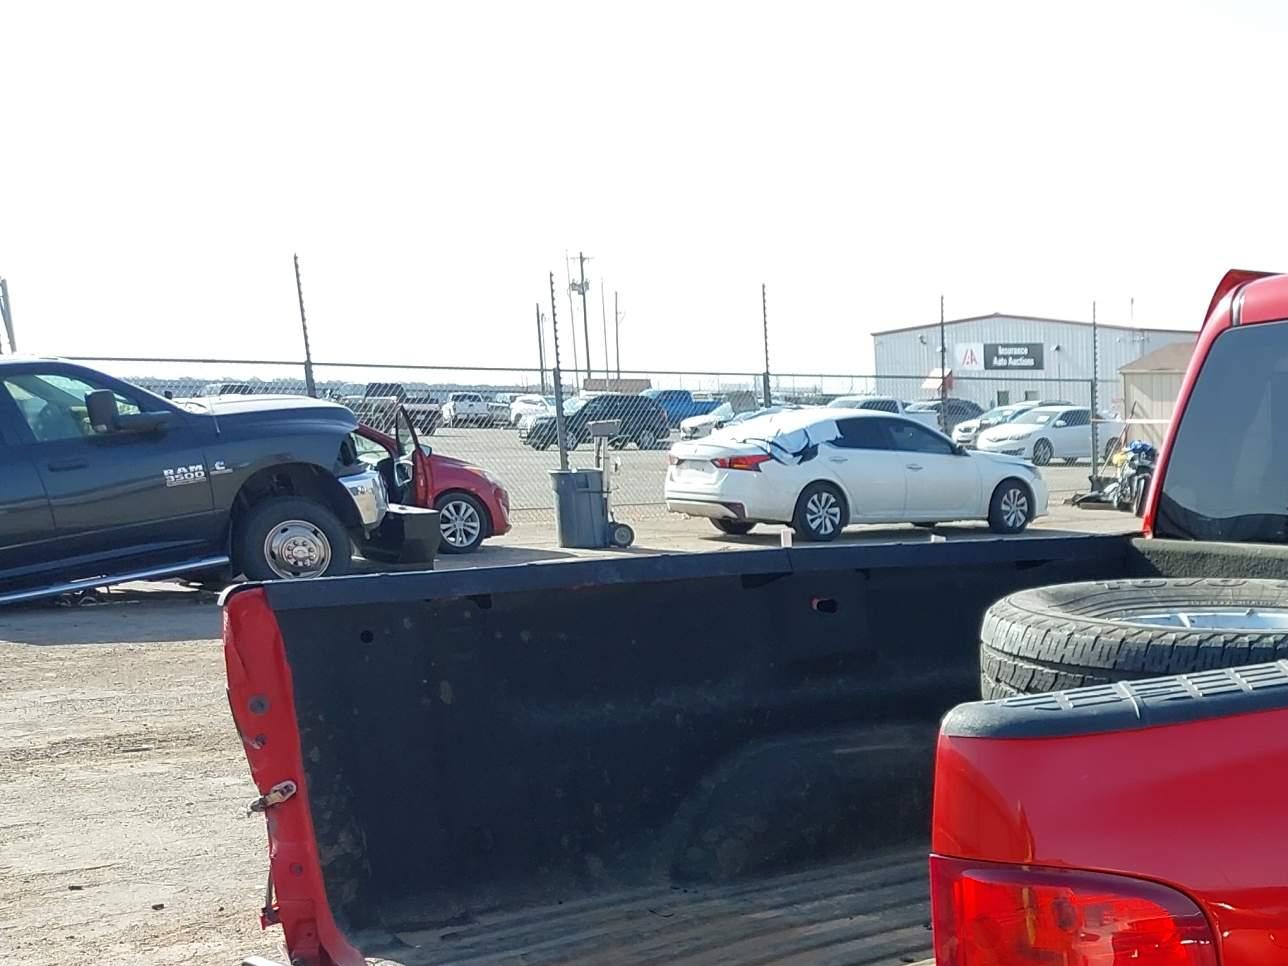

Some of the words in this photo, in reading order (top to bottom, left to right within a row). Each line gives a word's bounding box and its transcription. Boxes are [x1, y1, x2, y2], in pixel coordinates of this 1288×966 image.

[998, 345, 1028, 355] Insurance
[993, 356, 1007, 366] Auto
[1008, 355, 1035, 367] Auctions
[163, 465, 203, 476] RAM
[166, 471, 205, 481] 3500
